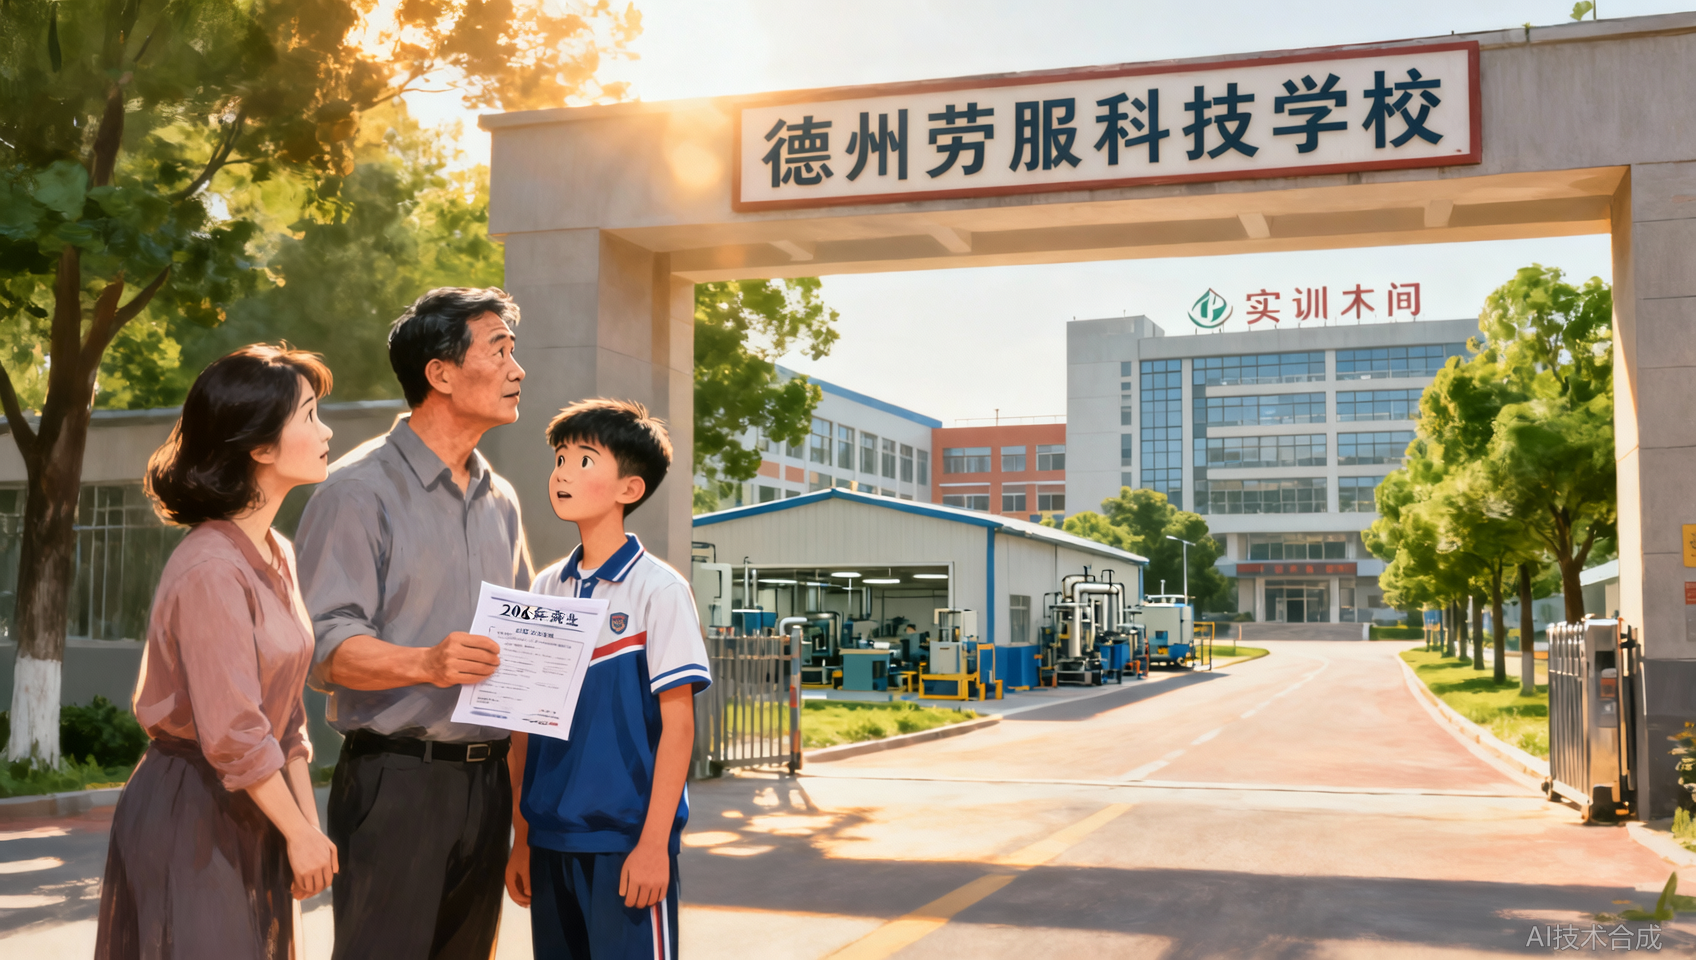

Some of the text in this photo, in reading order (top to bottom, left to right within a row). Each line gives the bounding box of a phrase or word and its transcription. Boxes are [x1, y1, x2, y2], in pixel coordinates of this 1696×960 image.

[761, 67, 1444, 188] 德州劳服科技学校
[1245, 282, 1421, 325] 实训木间
